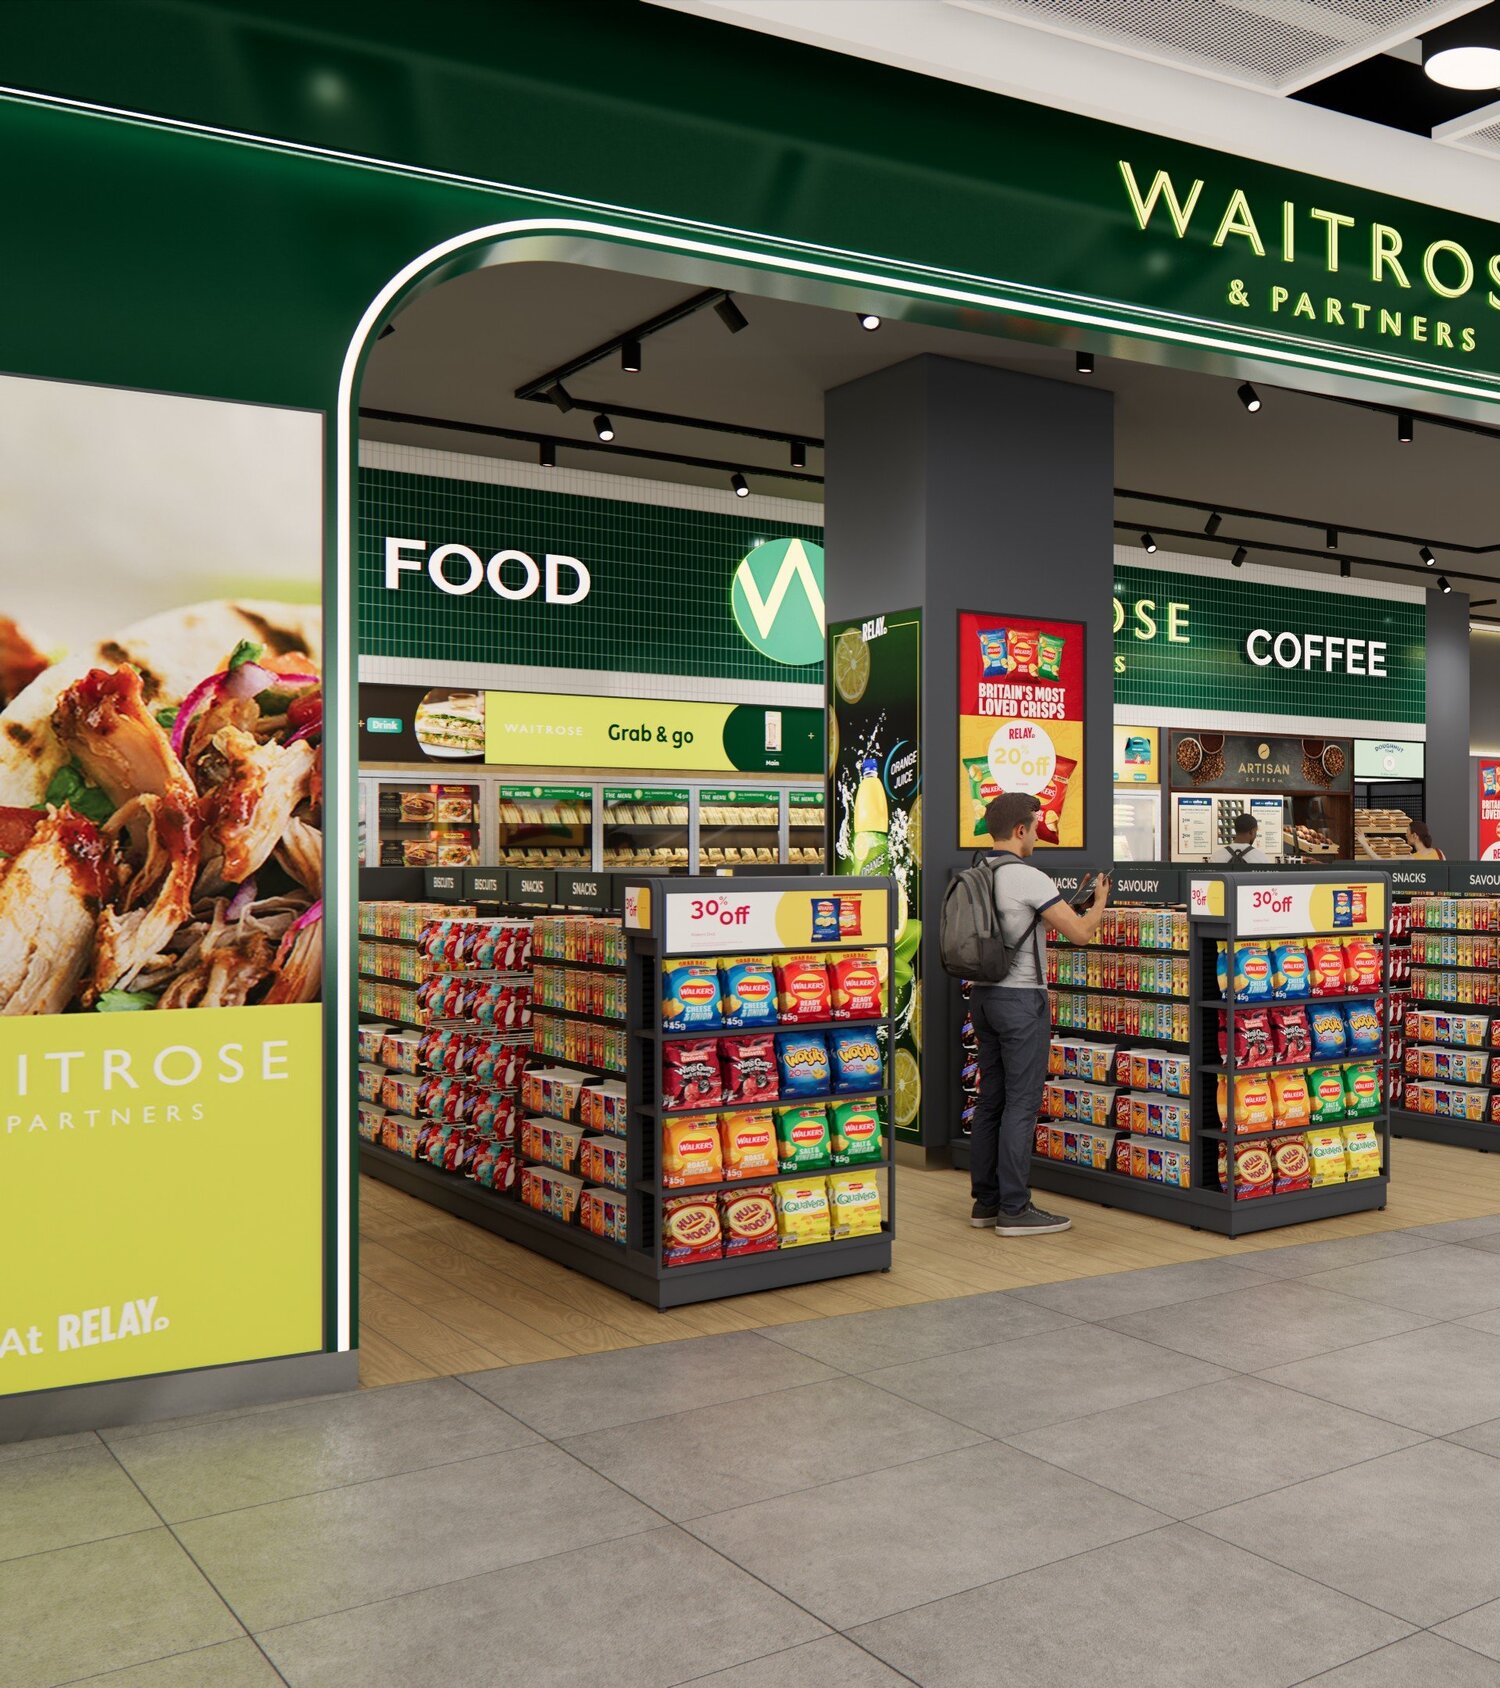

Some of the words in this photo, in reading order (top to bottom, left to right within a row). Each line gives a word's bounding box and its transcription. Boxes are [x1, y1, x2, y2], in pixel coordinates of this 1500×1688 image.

[1228, 279, 1250, 306] &
[1272, 285, 1476, 352] PARTNERS
[385, 537, 590, 604] FOOD
[1247, 629, 1387, 676] COFFEE
[978, 683, 1033, 700] BRITAIN'S
[1035, 686, 1065, 702] MOST
[978, 698, 1018, 716] LOVED
[1020, 700, 1065, 719] CRISPS
[372, 720, 398, 730] Drink
[504, 723, 583, 736] WAITROSE
[608, 724, 652, 743] Grab
[656, 727, 667, 742] &
[671, 731, 694, 749] go
[890, 750, 917, 775] ORANGE
[1021, 756, 1051, 776] off
[1238, 763, 1290, 775] ARTISAN
[894, 769, 913, 789] JUICE
[1482, 809, 1500, 820] LOVED
[433, 877, 454, 889] BISCUITS
[474, 878, 497, 891] BISCUITS
[1051, 877, 1078, 889] NACKS
[1392, 873, 1426, 883] SNACKS
[521, 880, 544, 893] SNACKS
[572, 882, 597, 896] SNACKS
[1117, 880, 1159, 893] SAVOURY
[1272, 896, 1293, 913] off
[720, 906, 750, 925] off
[738, 984, 770, 993] WALKERS
[792, 981, 824, 990] WALKERS
[845, 979, 876, 988] WALKERS
[680, 987, 714, 996] WALKERS
[1320, 1086, 1341, 1094] WALKERS
[1355, 1082, 1375, 1090] WALKERS
[7, 1103, 205, 1133] PARTNERS
[792, 1129, 824, 1138] WALKERS
[845, 1123, 875, 1132] WALKERS
[680, 1142, 713, 1151] WALKERS
[737, 1135, 769, 1144] WALKERS
[1243, 1155, 1262, 1170] HULA
[1281, 1149, 1300, 1164] HULA
[1286, 1155, 1306, 1172] HOOPS
[1249, 1161, 1269, 1179] HOOPS
[734, 1203, 762, 1222] HULA
[739, 1208, 771, 1231] HOOPS
[677, 1211, 706, 1231] HULA
[683, 1216, 716, 1240] HOOPS
[0, 1328, 44, 1359] At
